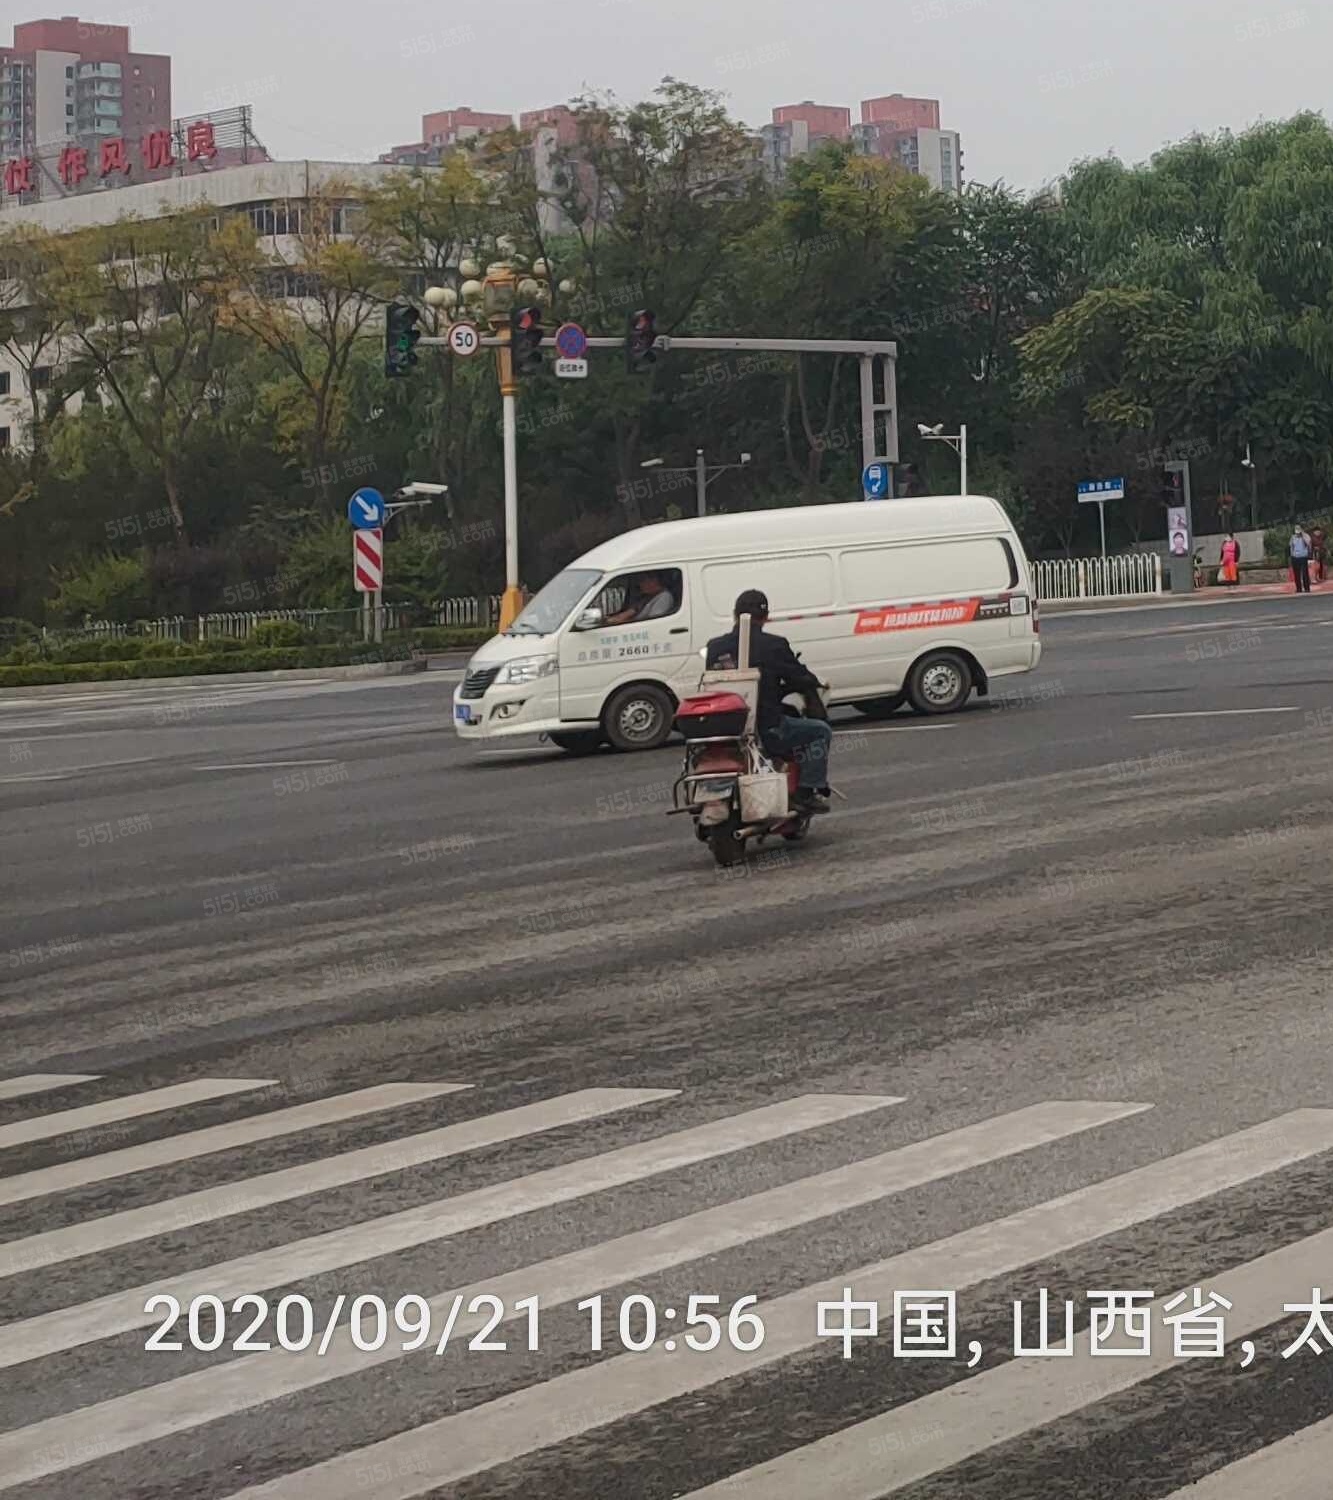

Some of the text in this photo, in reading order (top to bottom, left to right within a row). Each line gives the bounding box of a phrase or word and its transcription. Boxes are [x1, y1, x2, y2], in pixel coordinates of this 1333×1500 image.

[57, 120, 218, 187] 作风优良
[455, 331, 473, 347] 50
[618, 644, 650, 657] 2660
